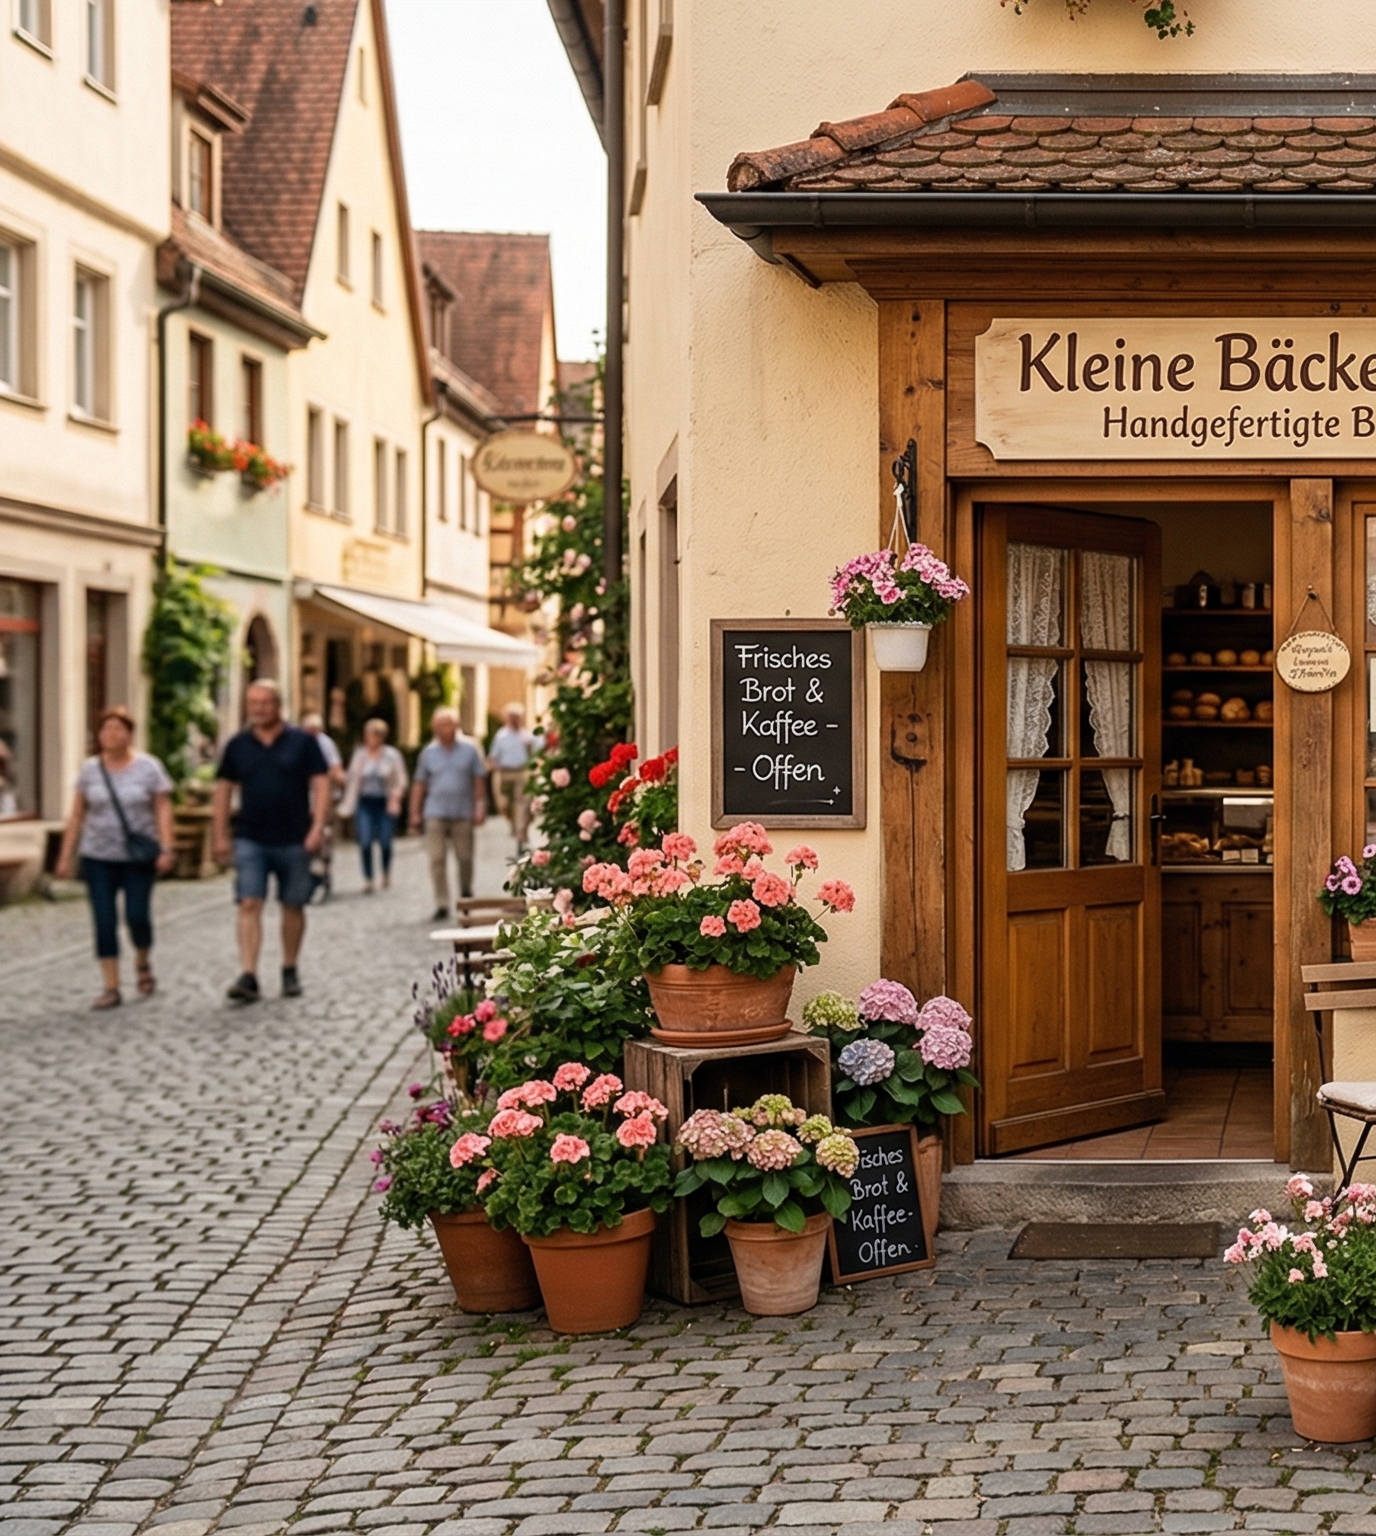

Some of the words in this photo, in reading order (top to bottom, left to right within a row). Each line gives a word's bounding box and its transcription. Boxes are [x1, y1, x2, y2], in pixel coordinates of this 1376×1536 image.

[1018, 331, 1195, 393] Kleine
[1102, 404, 1340, 448] Handgefertigte
[734, 643, 832, 669] Frisches
[739, 677, 796, 703] Brot
[805, 677, 824, 704] &
[742, 710, 819, 745] Kaffee
[752, 753, 826, 791] Offen
[860, 1146, 904, 1170] isches
[849, 1173, 889, 1201] Brot
[896, 1170, 909, 1194] &
